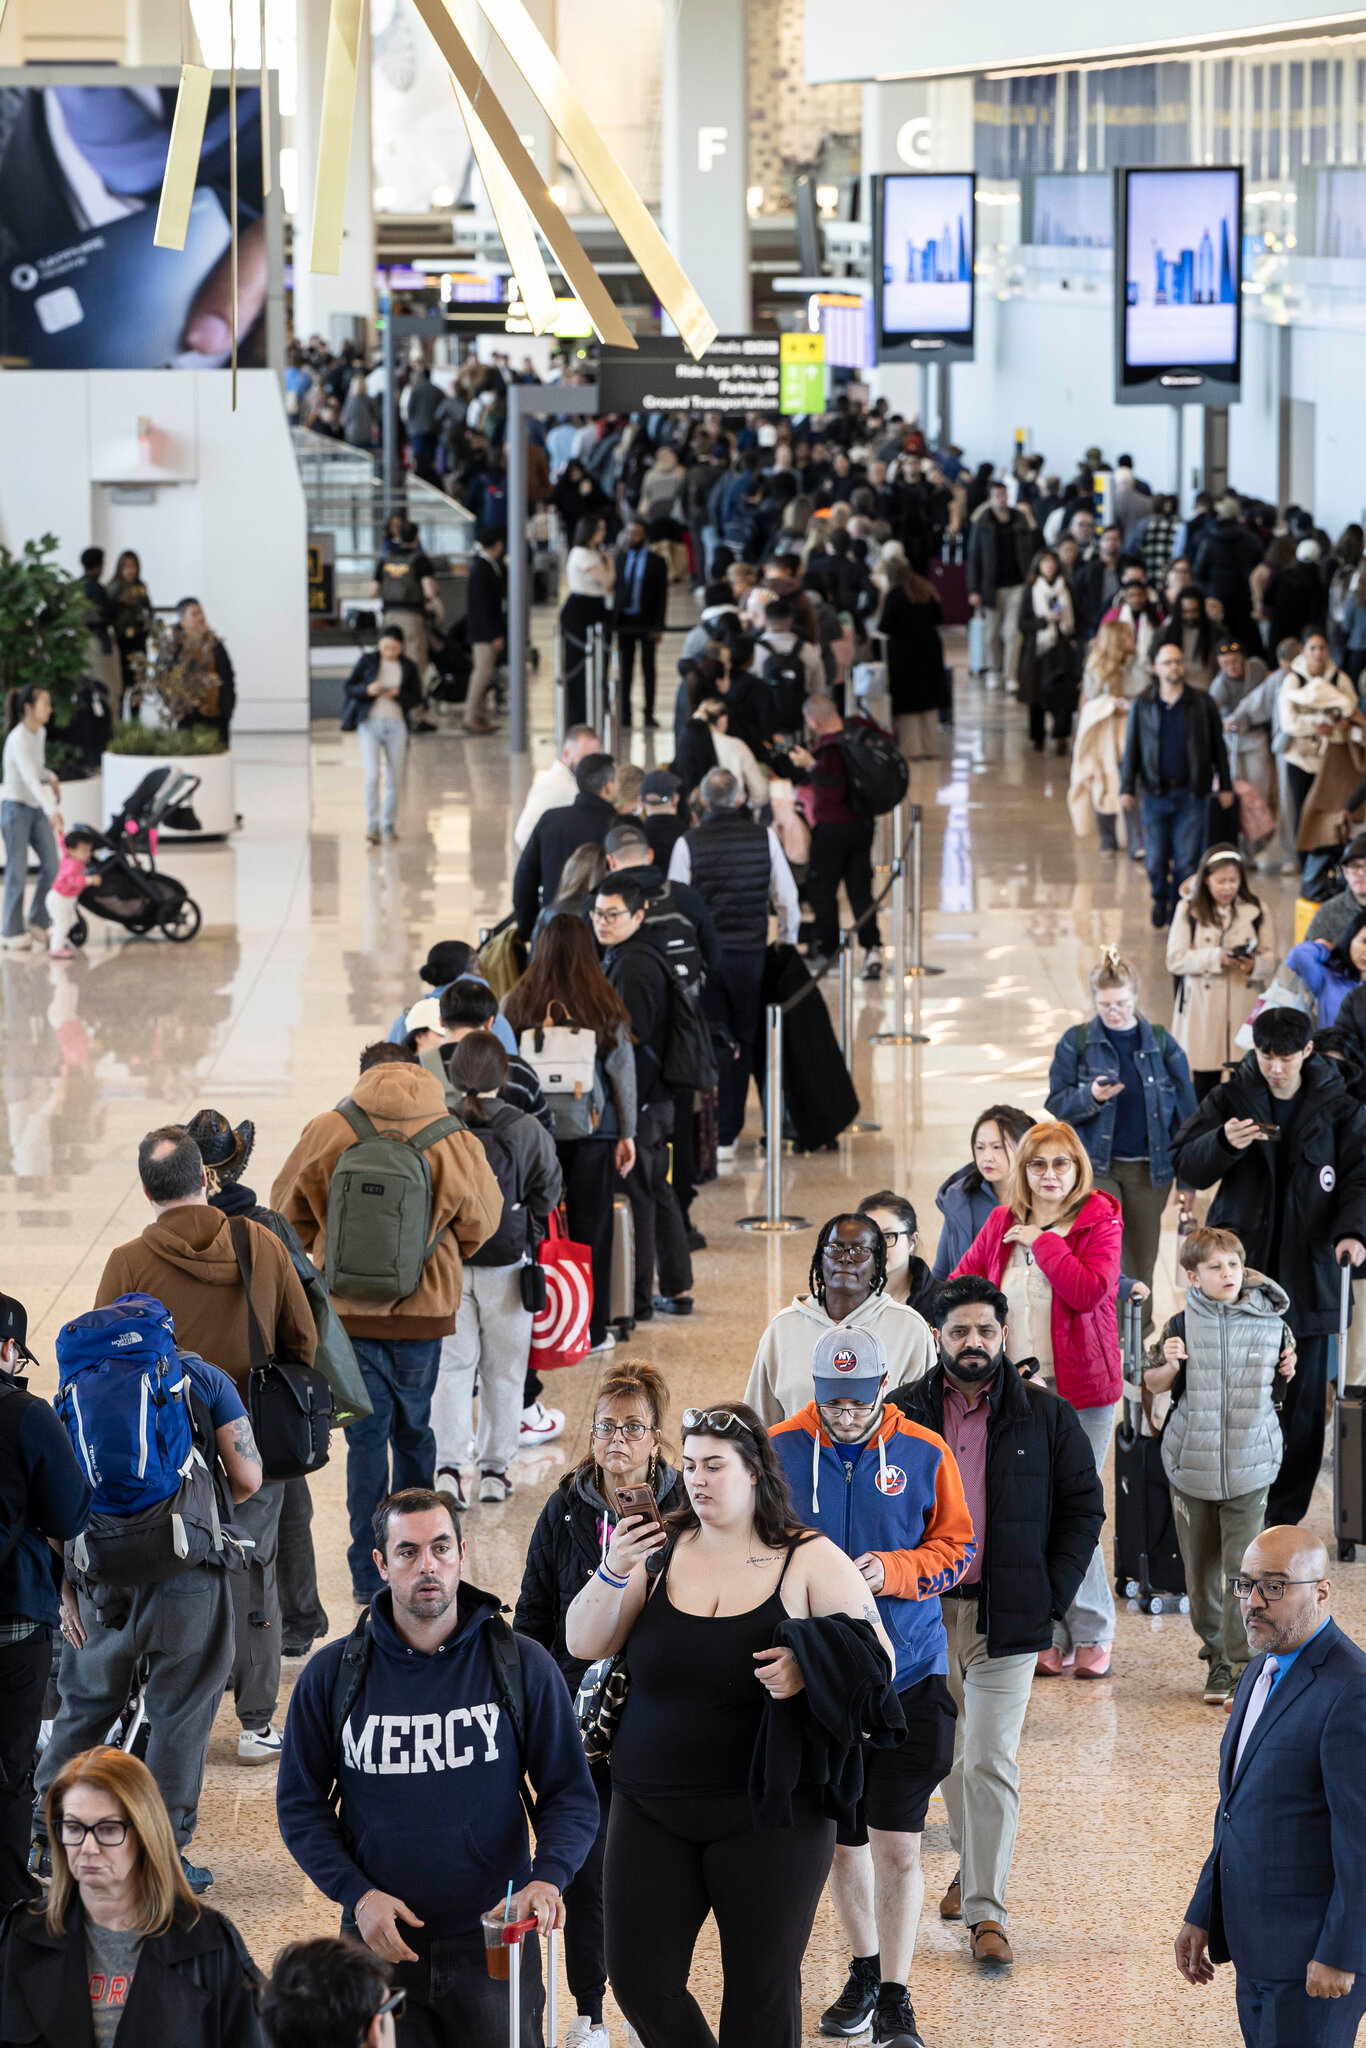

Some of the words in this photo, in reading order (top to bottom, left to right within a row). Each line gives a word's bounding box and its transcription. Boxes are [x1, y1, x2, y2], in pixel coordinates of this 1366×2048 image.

[697, 126, 728, 173] F
[896, 116, 932, 169] G
[642, 394, 690, 409] Ground
[691, 394, 780, 412] Transportation
[342, 1702, 500, 1775] MERCY
[88, 1973, 134, 2004] OR
